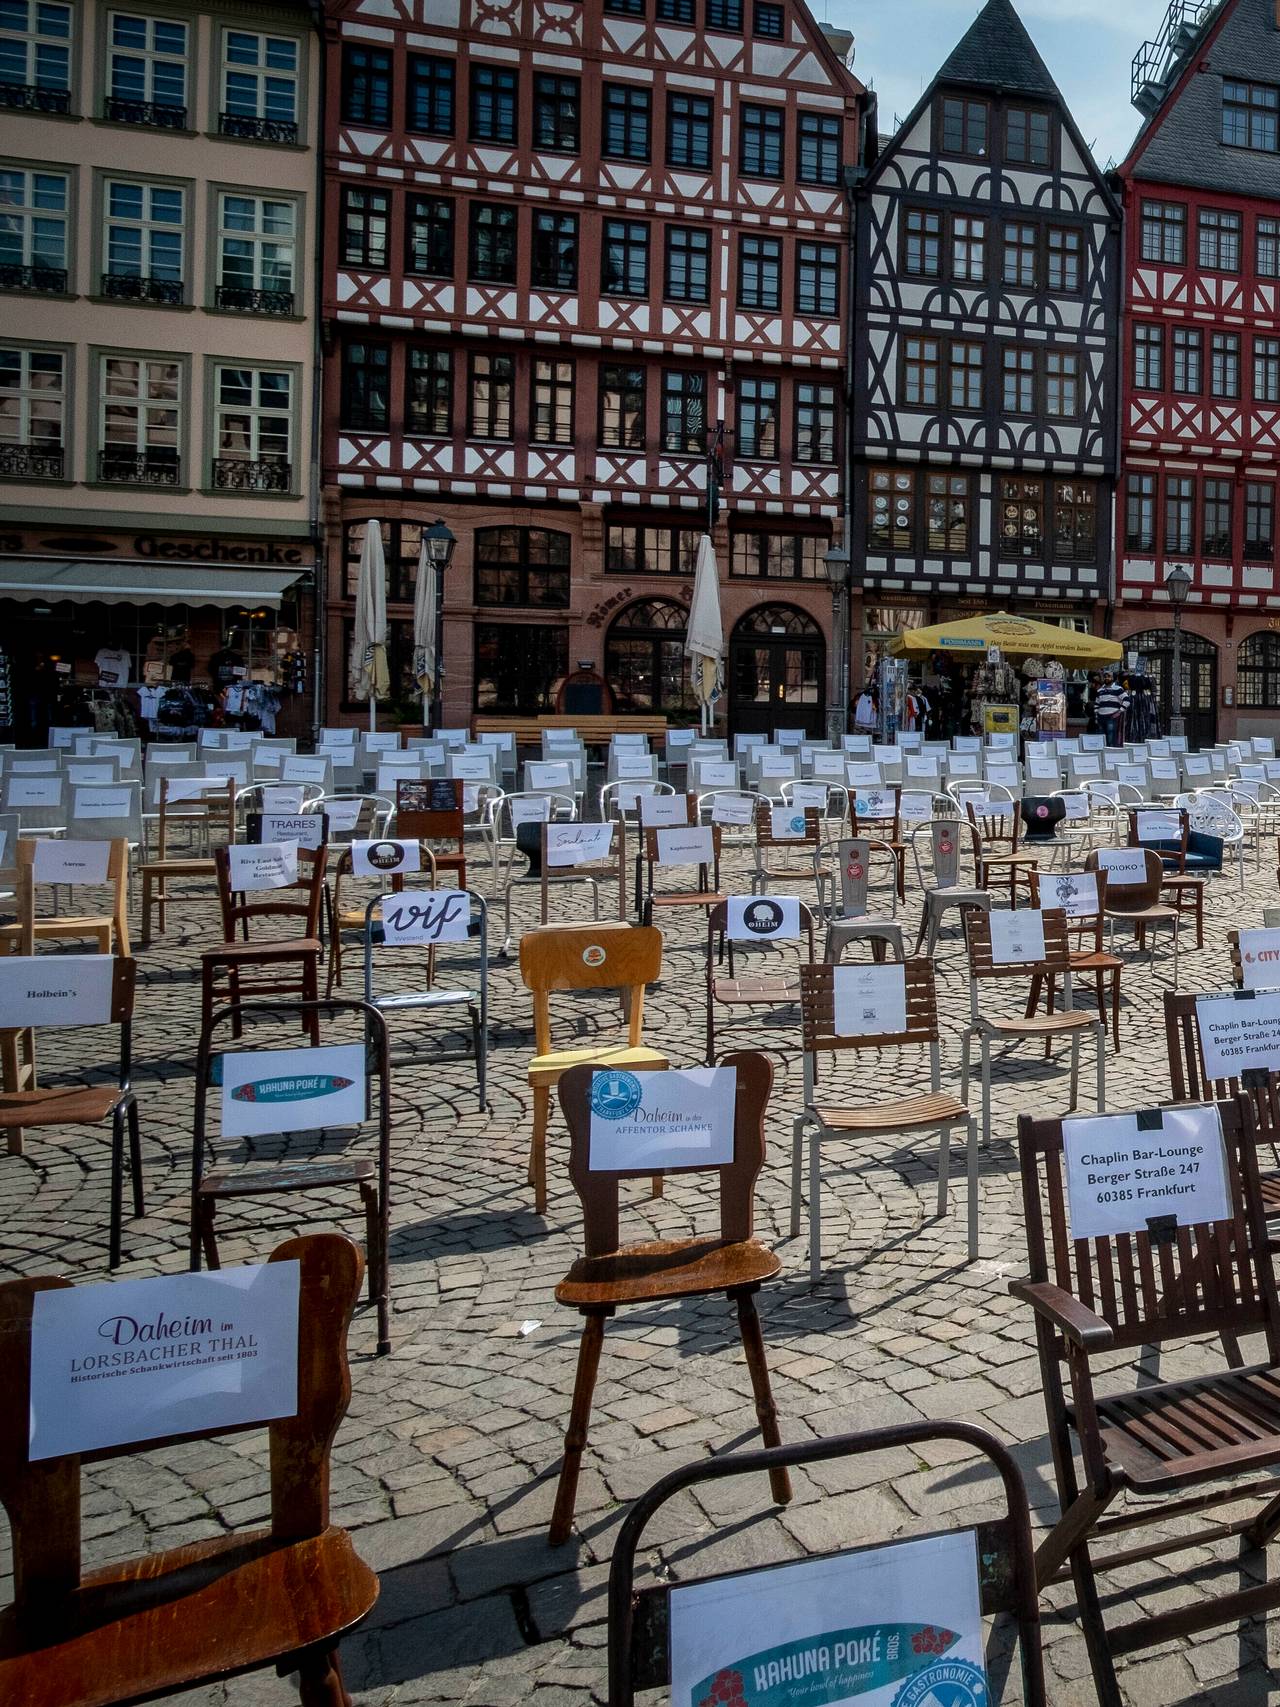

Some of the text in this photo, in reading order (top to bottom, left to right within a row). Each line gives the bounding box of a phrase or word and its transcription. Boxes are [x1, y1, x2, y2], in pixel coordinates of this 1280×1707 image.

[134, 535, 303, 563] Geschenke
[586, 587, 632, 629] Römer
[270, 820, 316, 829] TRARES
[387, 894, 466, 939] vif
[26, 988, 77, 999] Holbein's
[1208, 1020, 1240, 1033] Chaplin
[1214, 1033, 1242, 1046] Berger
[1244, 1031, 1270, 1042] Straße
[1220, 1046, 1243, 1058] 60385
[258, 1080, 295, 1094] KAHUNA
[296, 1077, 318, 1089] POKÉ
[633, 1107, 683, 1123] Daheim
[615, 1125, 666, 1134] AFFENTOR
[1080, 1144, 1204, 1168] Chaplin Bar-Lounge
[1087, 1162, 1200, 1187] Berger Straße 247
[1096, 1183, 1196, 1204] 60385 Frankfurt
[98, 1312, 233, 1346] Daheim im
[71, 1334, 259, 1373] LORSBACHER THAL
[71, 1350, 259, 1384] Historische Schankwirtschaft seit 1803
[753, 1630, 881, 1692] KAHUNA POKÉ
[787, 1670, 874, 1698] Your bowl of happiness
[906, 1667, 974, 1701] GASTRONOMIE
